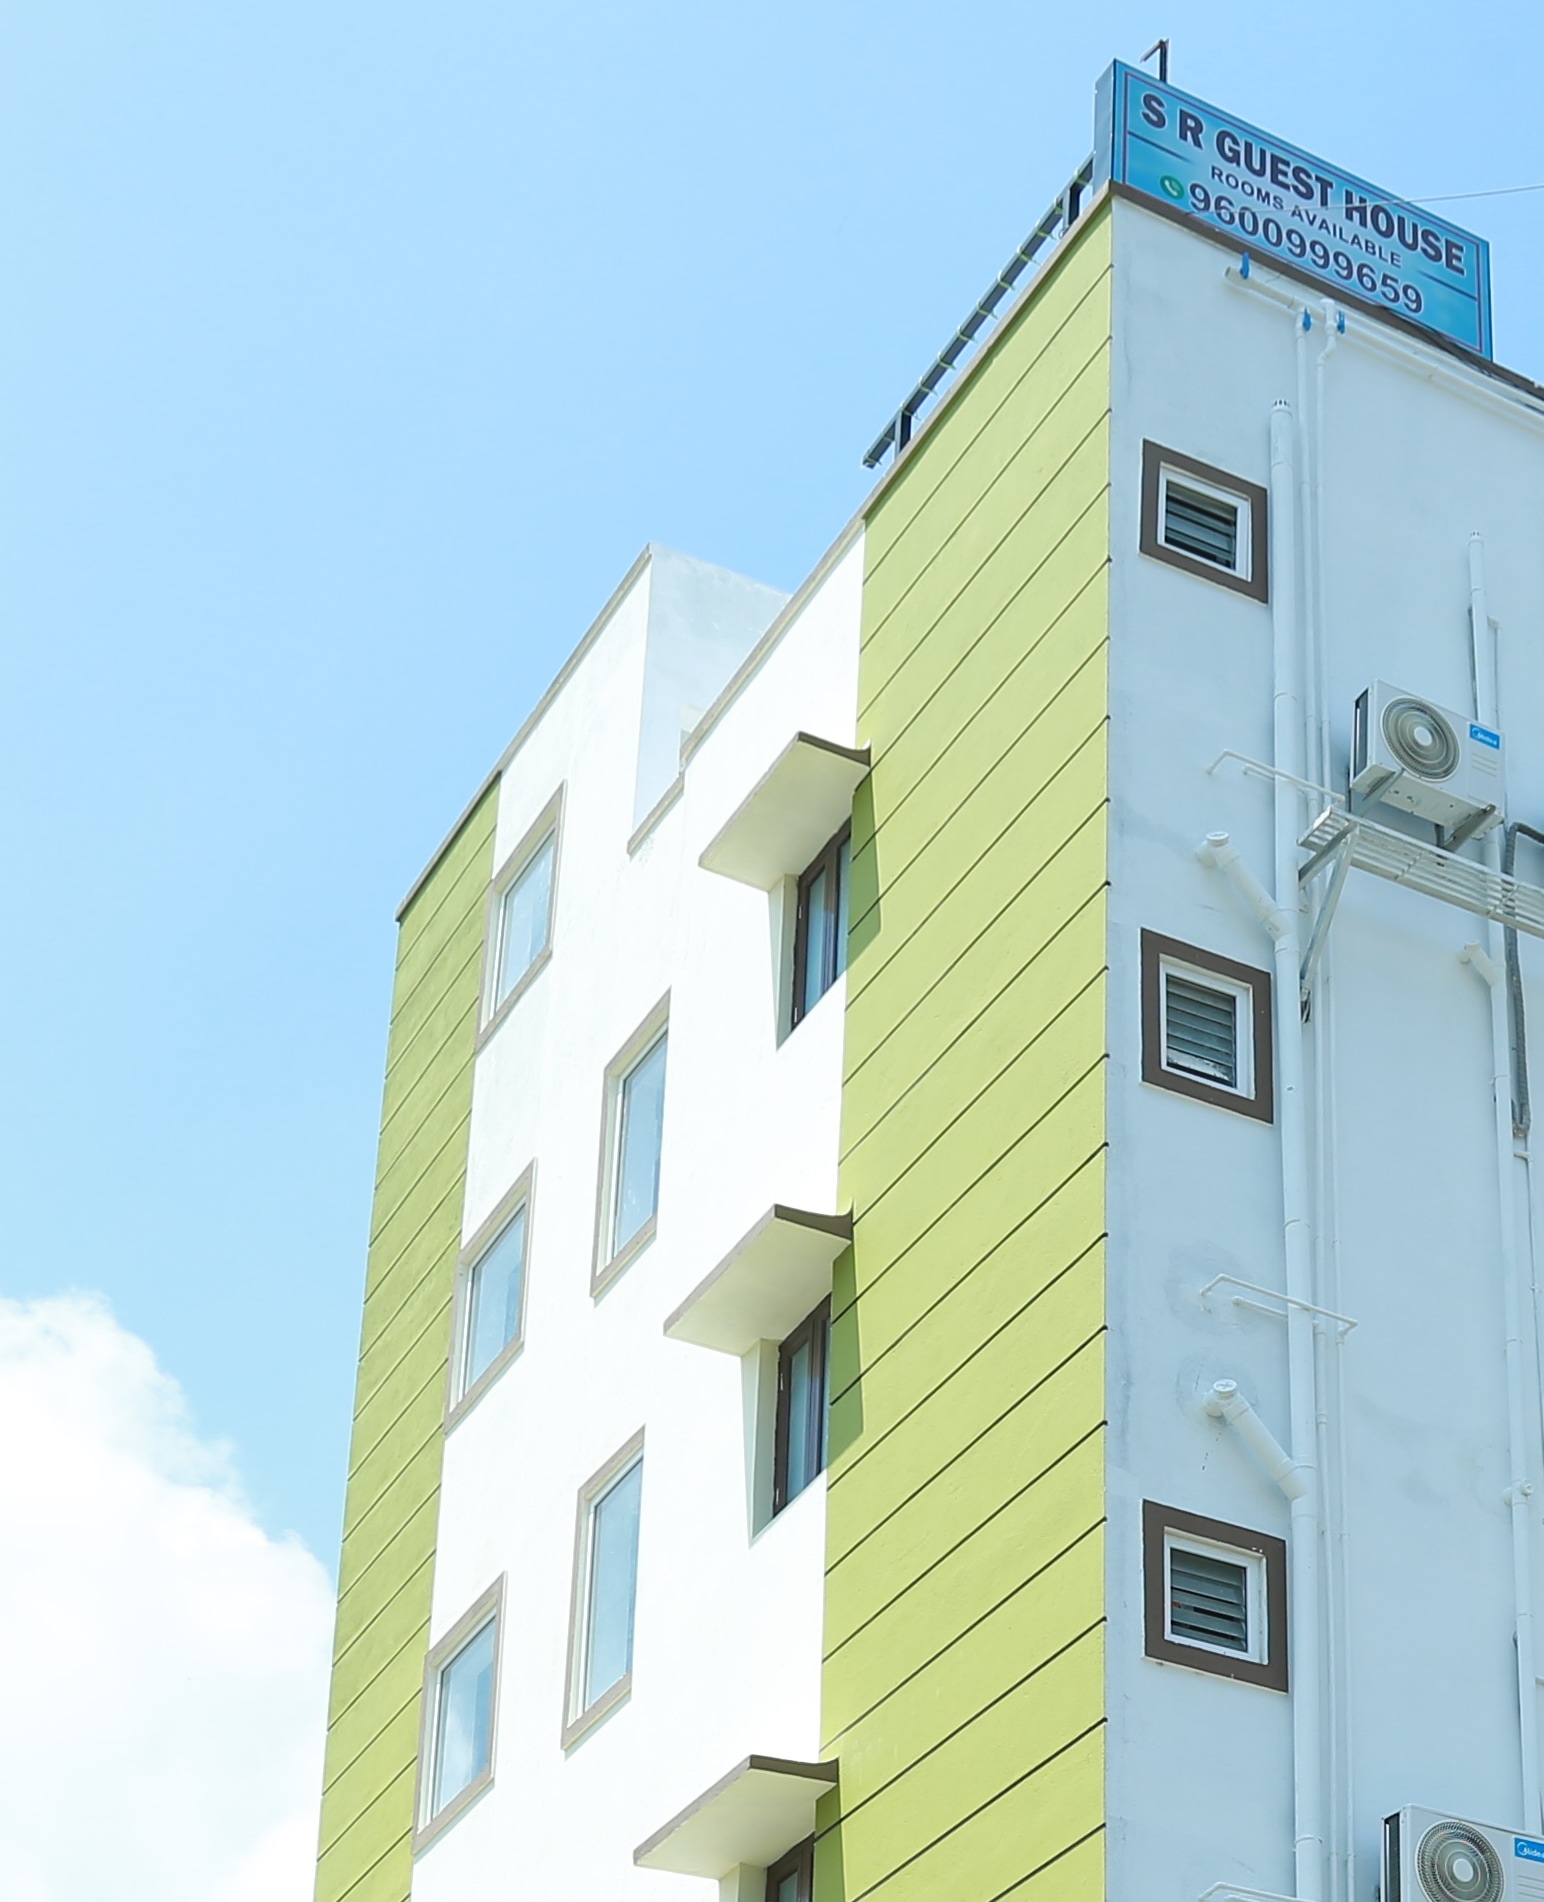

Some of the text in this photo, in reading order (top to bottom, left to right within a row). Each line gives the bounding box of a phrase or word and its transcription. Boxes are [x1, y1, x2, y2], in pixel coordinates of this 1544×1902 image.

[1141, 93, 1466, 276] S R GUEST HOUSE
[1189, 183, 1422, 313] 9600999659
[1211, 165, 1402, 268] ROOMS AVAILABLE
